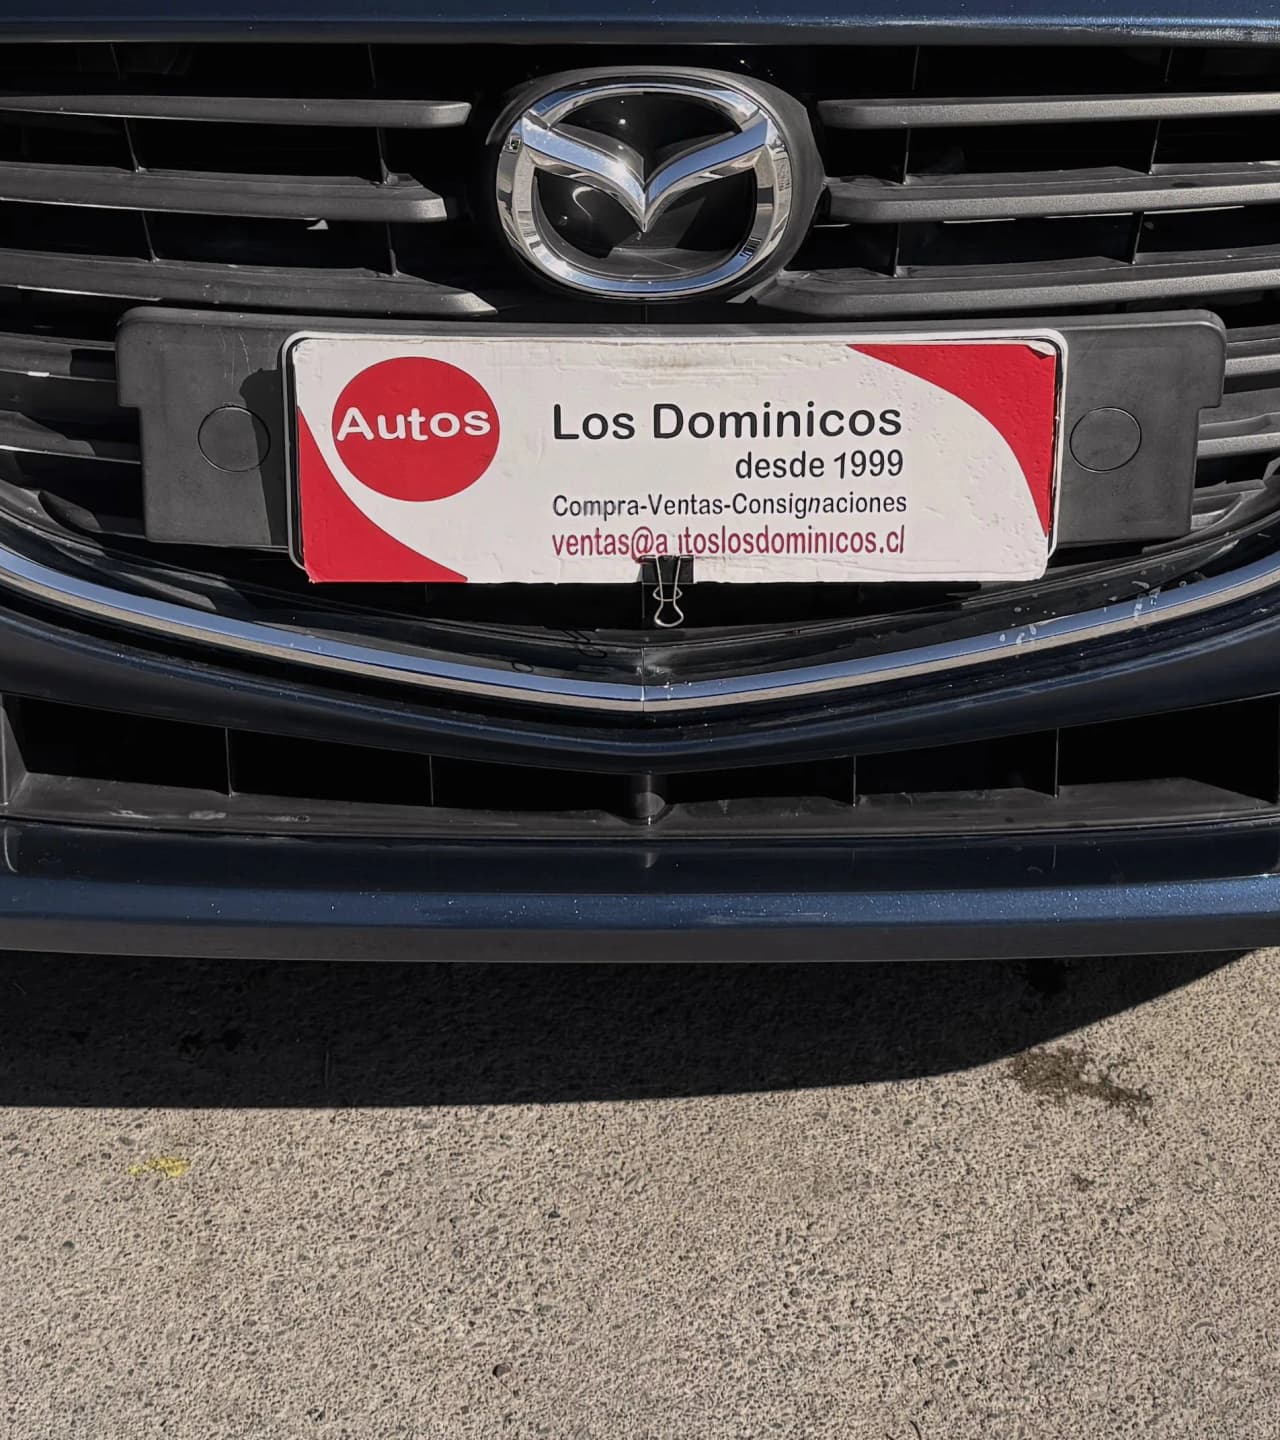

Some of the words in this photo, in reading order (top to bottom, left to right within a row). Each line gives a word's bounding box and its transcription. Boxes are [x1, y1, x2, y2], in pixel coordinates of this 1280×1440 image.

[336, 405, 492, 442] Autos
[553, 403, 636, 441] Los
[652, 399, 902, 439] Dominicos
[735, 450, 825, 479] desde
[833, 449, 904, 479] 1999
[552, 492, 908, 521] Compra-Ventas-Consignaciones
